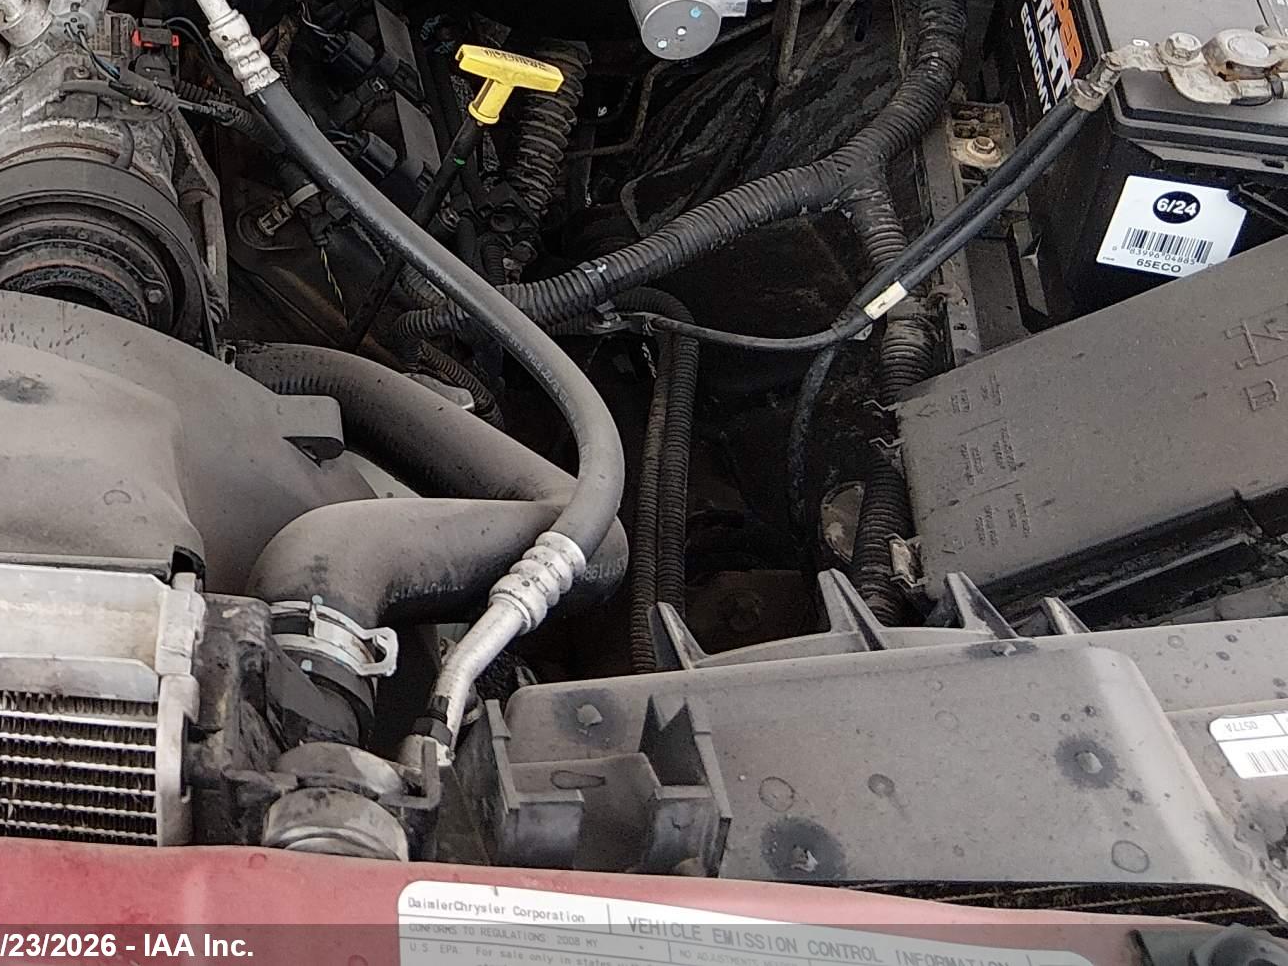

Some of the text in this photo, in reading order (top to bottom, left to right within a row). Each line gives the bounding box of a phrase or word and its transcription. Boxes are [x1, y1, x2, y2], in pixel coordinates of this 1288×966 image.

[1020, 1, 1052, 115] ECONOMY
[1156, 197, 1198, 217] 6/24
[1129, 247, 1160, 259] 83996
[1136, 258, 1182, 273] 65ECO
[408, 896, 585, 923] DaimlerChrysler Corporation
[409, 923, 458, 936] CONFORMS
[464, 925, 476, 937] TO
[557, 934, 582, 947] 2008
[627, 916, 702, 941] VEHICLE
[712, 928, 799, 955] EMISSION
[807, 940, 882, 965] CONTROL
[476, 945, 494, 957] For
[500, 948, 524, 960] sale
